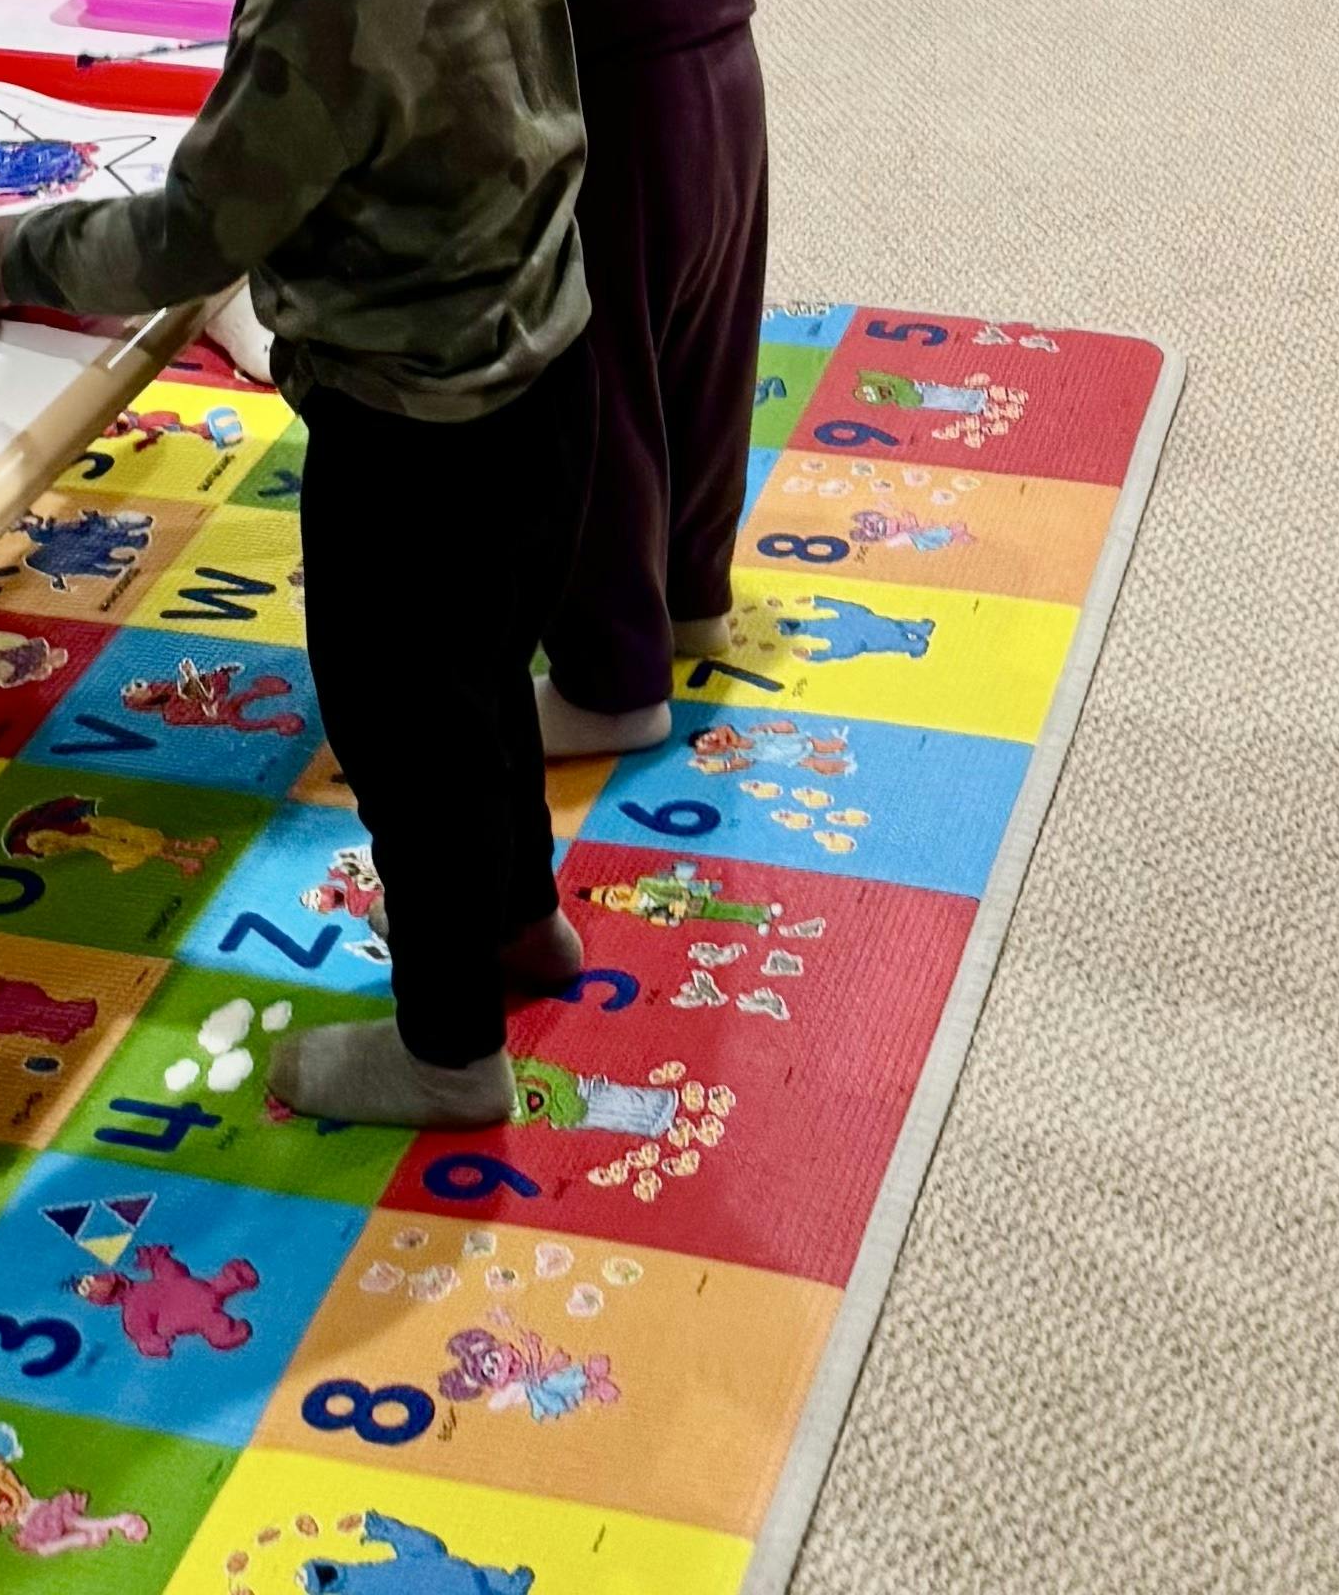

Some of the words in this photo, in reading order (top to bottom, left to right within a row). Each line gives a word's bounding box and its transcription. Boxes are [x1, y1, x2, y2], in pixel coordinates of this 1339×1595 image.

[865, 319, 949, 347] 5
[756, 532, 850, 564] 8
[686, 660, 784, 692] 7
[51, 715, 157, 755] V
[94, 1097, 222, 1153] 4
[301, 1378, 436, 1446] 8
